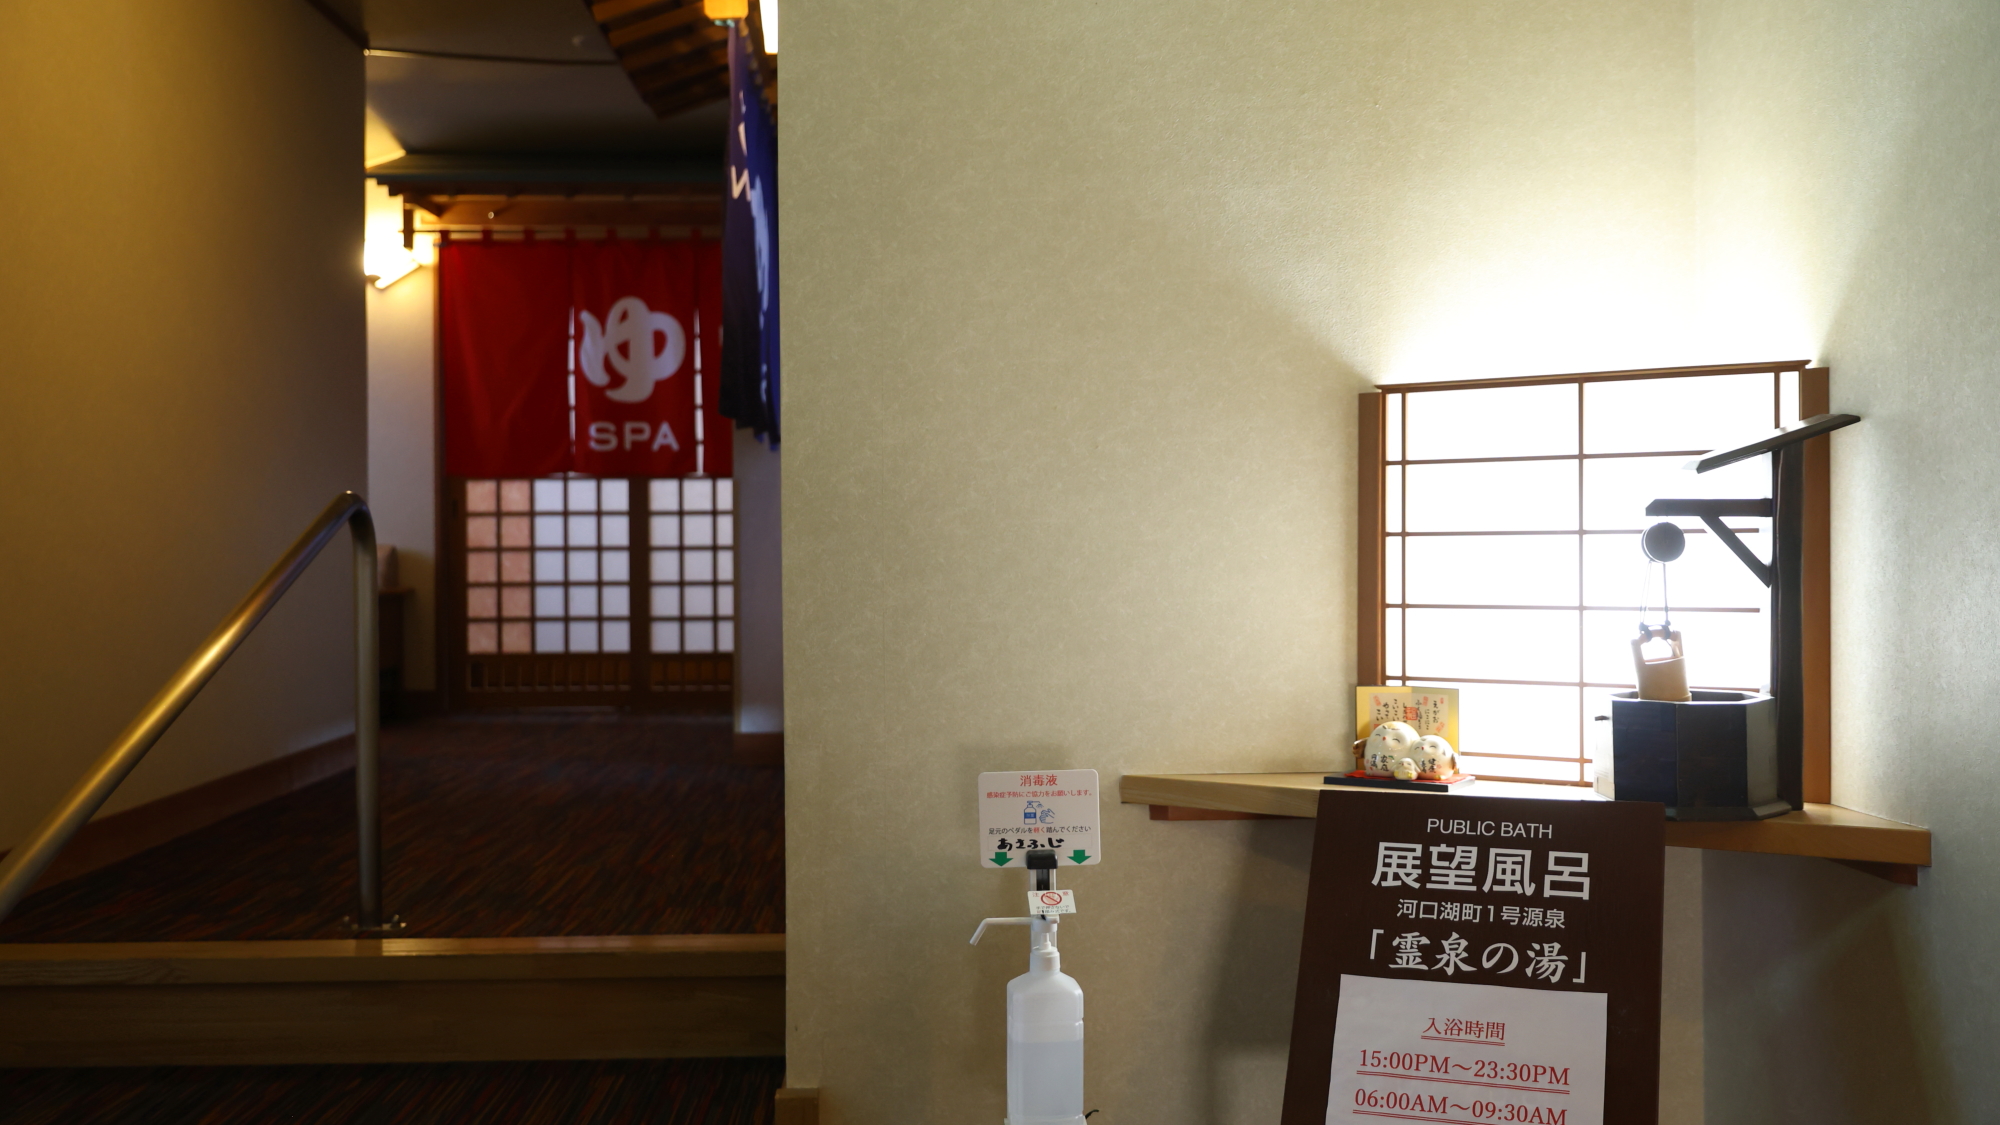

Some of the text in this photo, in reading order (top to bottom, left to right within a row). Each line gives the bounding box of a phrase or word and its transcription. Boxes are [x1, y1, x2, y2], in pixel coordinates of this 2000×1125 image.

[580, 297, 685, 402] ゆ
[588, 422, 679, 450] SPA
[1020, 774, 1058, 787] 消毒液
[1427, 818, 1553, 839] PUBLIC BATH
[1371, 841, 1591, 900] 展望風呂
[1396, 898, 1566, 929] 河口湖町1号源泉
[1369, 928, 1587, 984] 「霊泉の湯」
[1422, 1017, 1506, 1040] 入浴時間
[1359, 1049, 1571, 1086] 15:00PM～23:30PM
